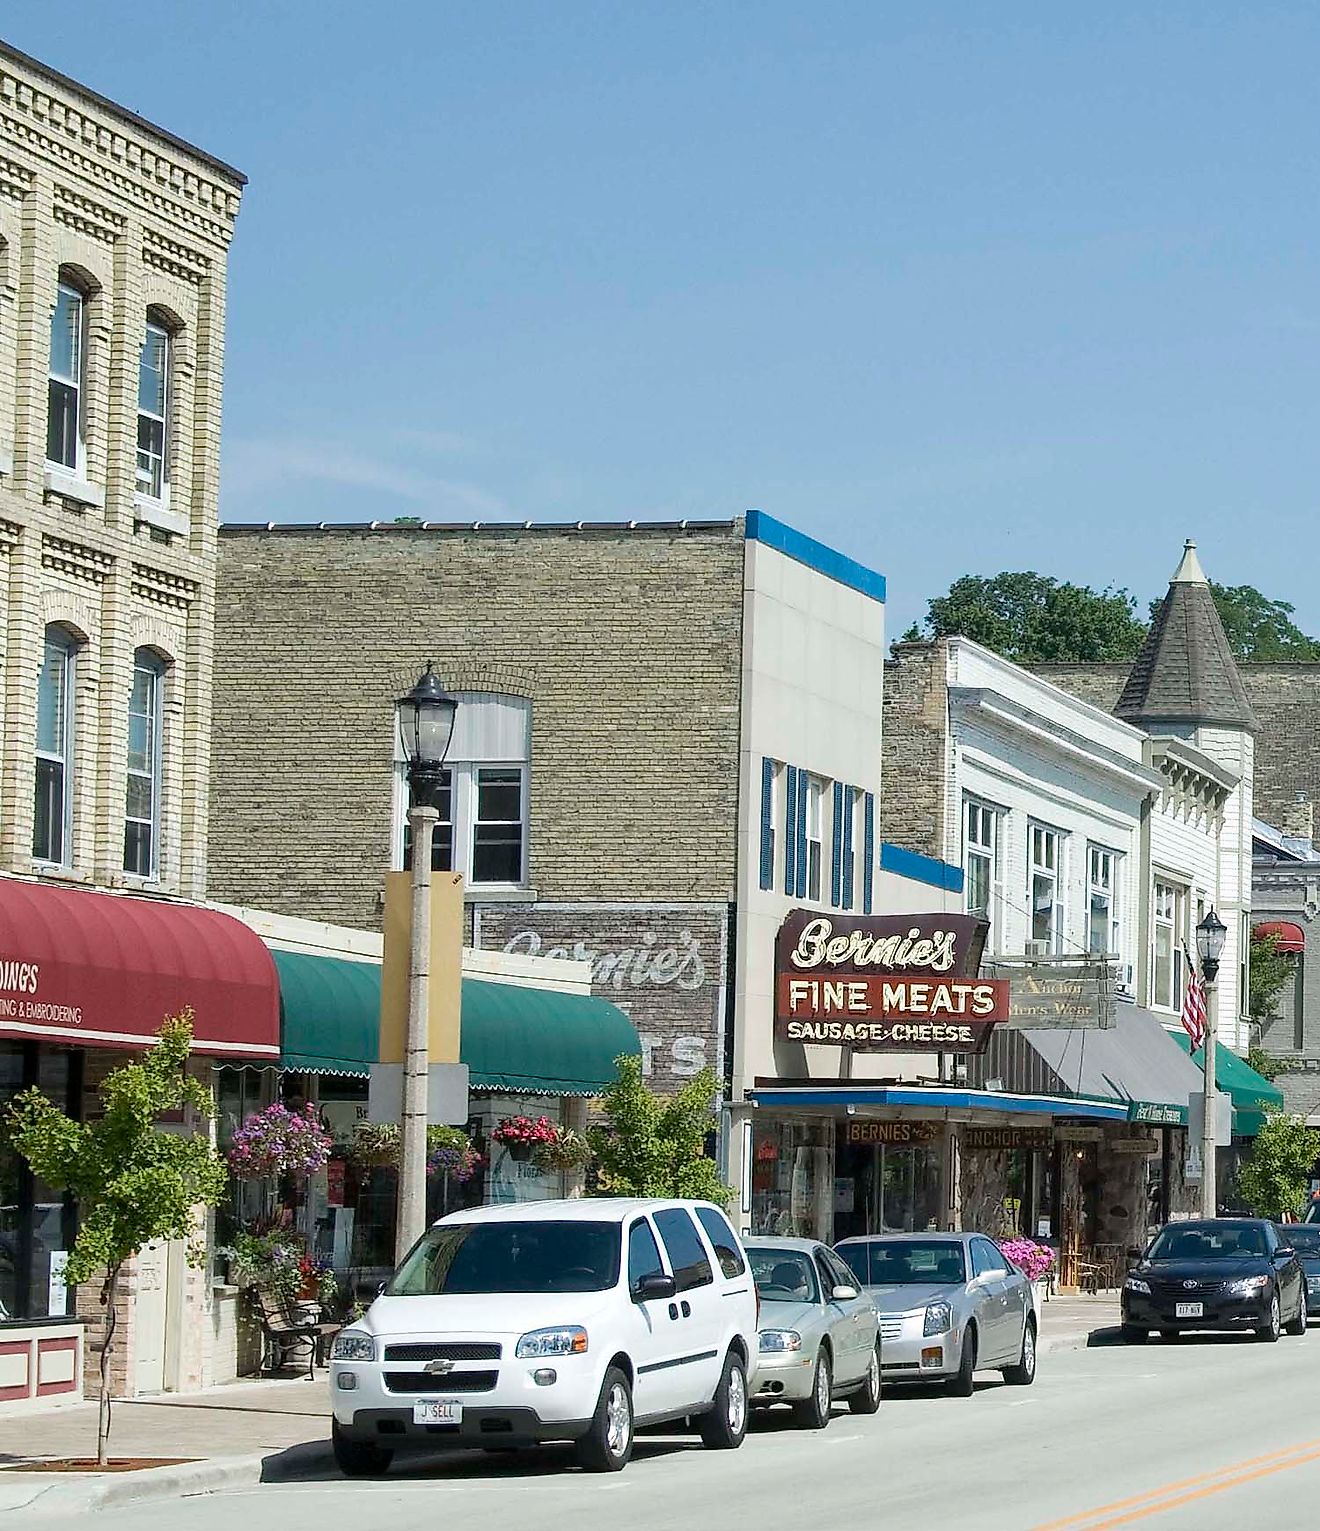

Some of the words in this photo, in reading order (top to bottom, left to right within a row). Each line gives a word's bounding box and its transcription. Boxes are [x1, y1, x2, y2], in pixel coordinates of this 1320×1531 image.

[790, 918, 957, 972] Bernie's
[1025, 975, 1083, 995] Anchor
[788, 980, 872, 1013] FINE
[882, 982, 995, 1015] MEATS
[19, 1001, 25, 1017] &
[1054, 1001, 1092, 1016] Wear
[851, 1123, 911, 1141] BERNIES
[421, 1405, 427, 1418] J
[432, 1405, 454, 1418] SELL
